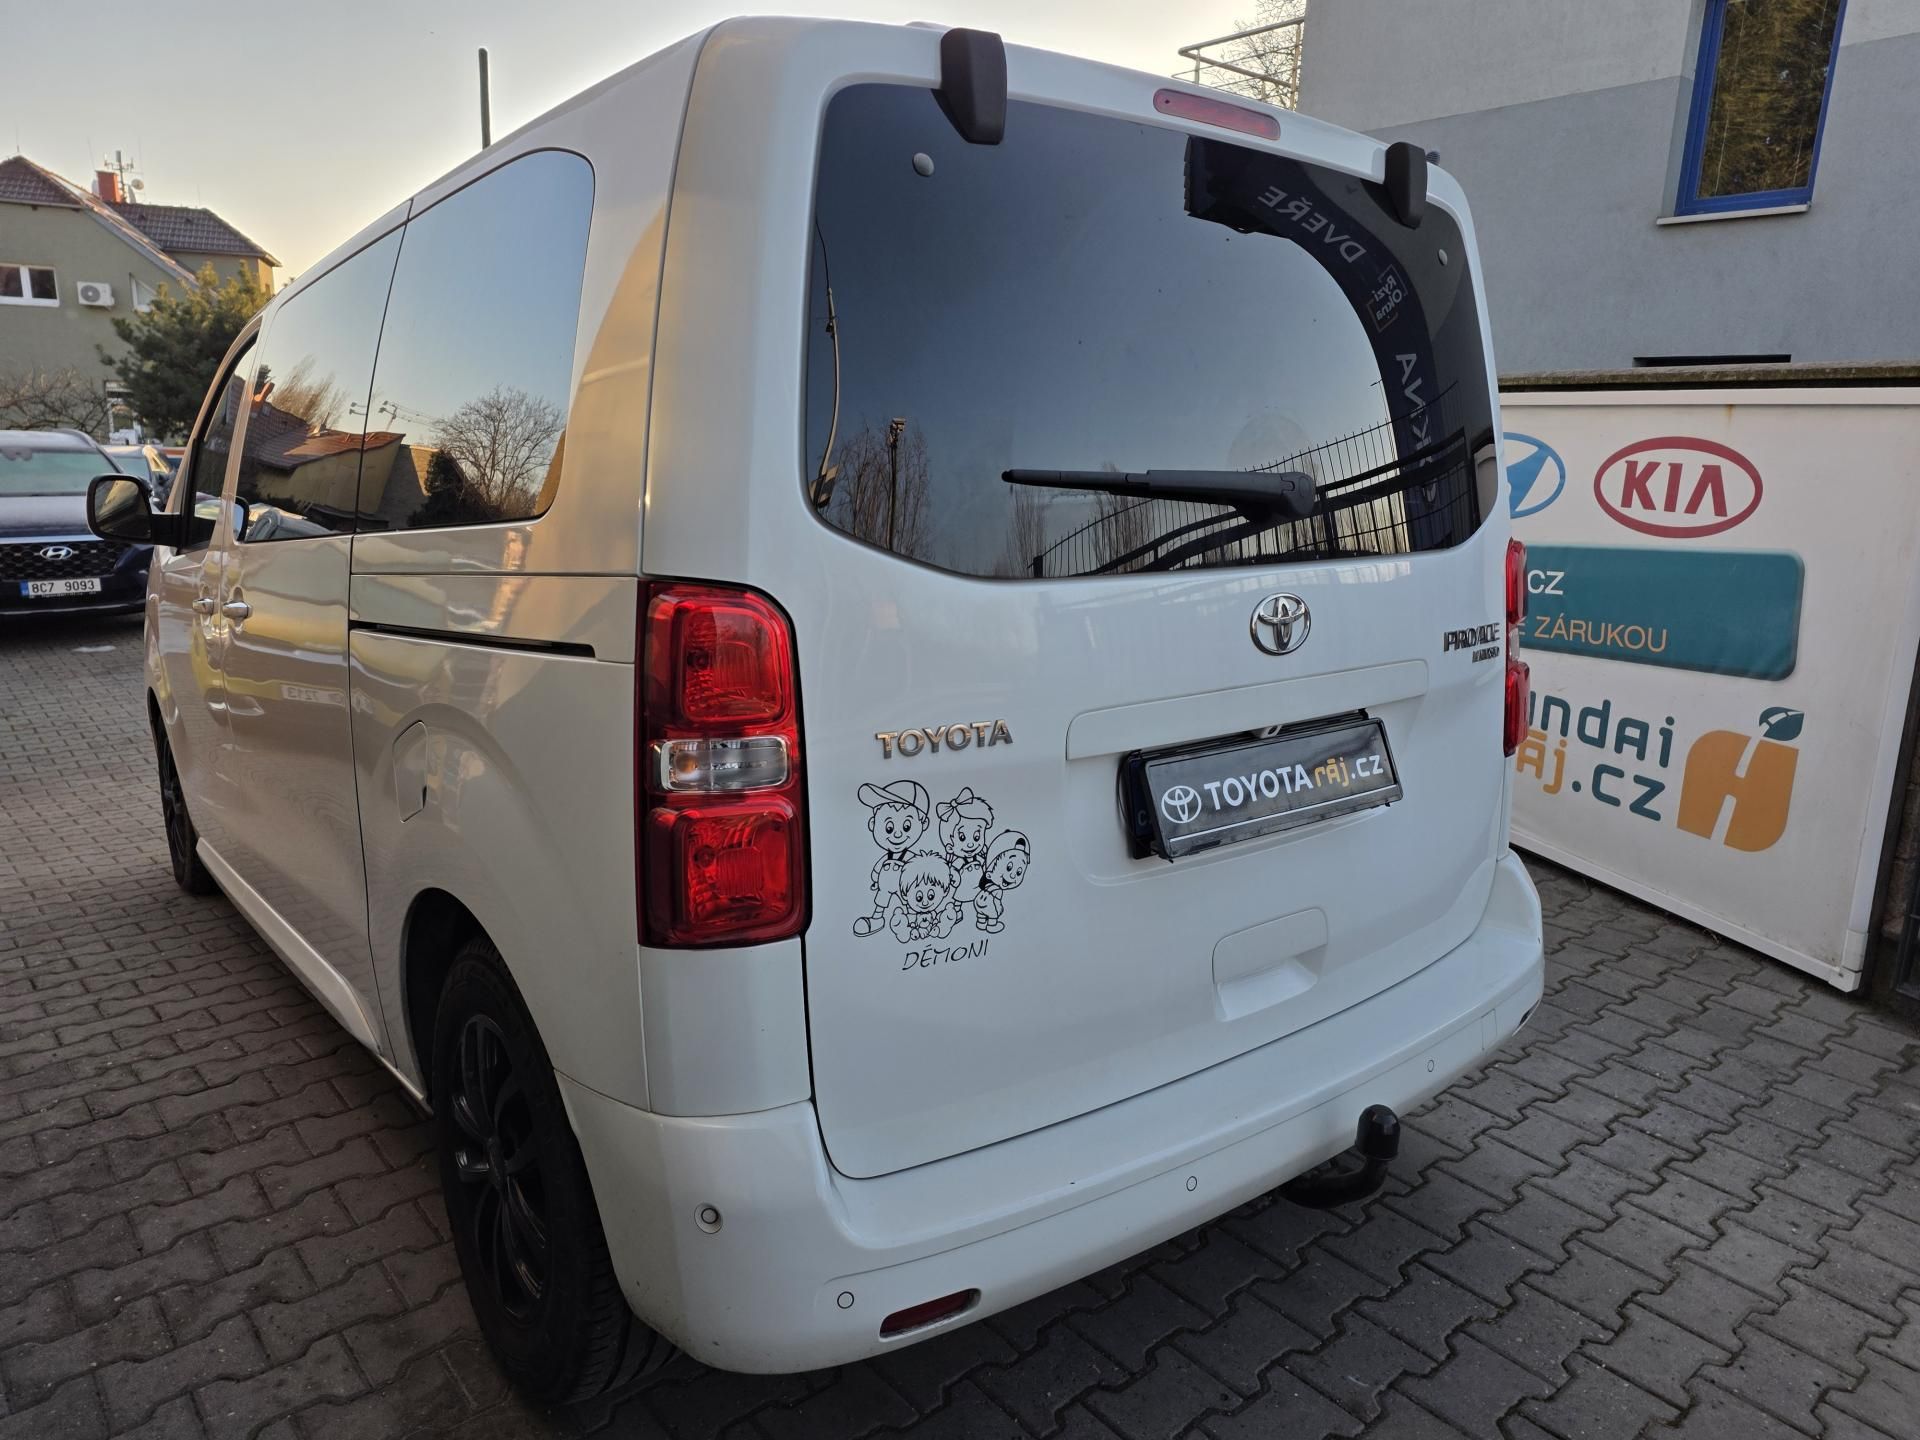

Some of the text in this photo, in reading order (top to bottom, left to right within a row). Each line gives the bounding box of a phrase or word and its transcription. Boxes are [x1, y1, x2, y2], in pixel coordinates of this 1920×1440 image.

[1620, 458, 1729, 517] KIA
[32, 582, 54, 594] 8C7
[64, 580, 95, 592] 9093
[1527, 569, 1565, 596] CZ
[1534, 612, 1668, 653] ZÁRUKOU
[874, 718, 1014, 760] TOYOTA
[1528, 691, 1676, 768] ndai
[902, 938, 989, 972] DÉMONI
